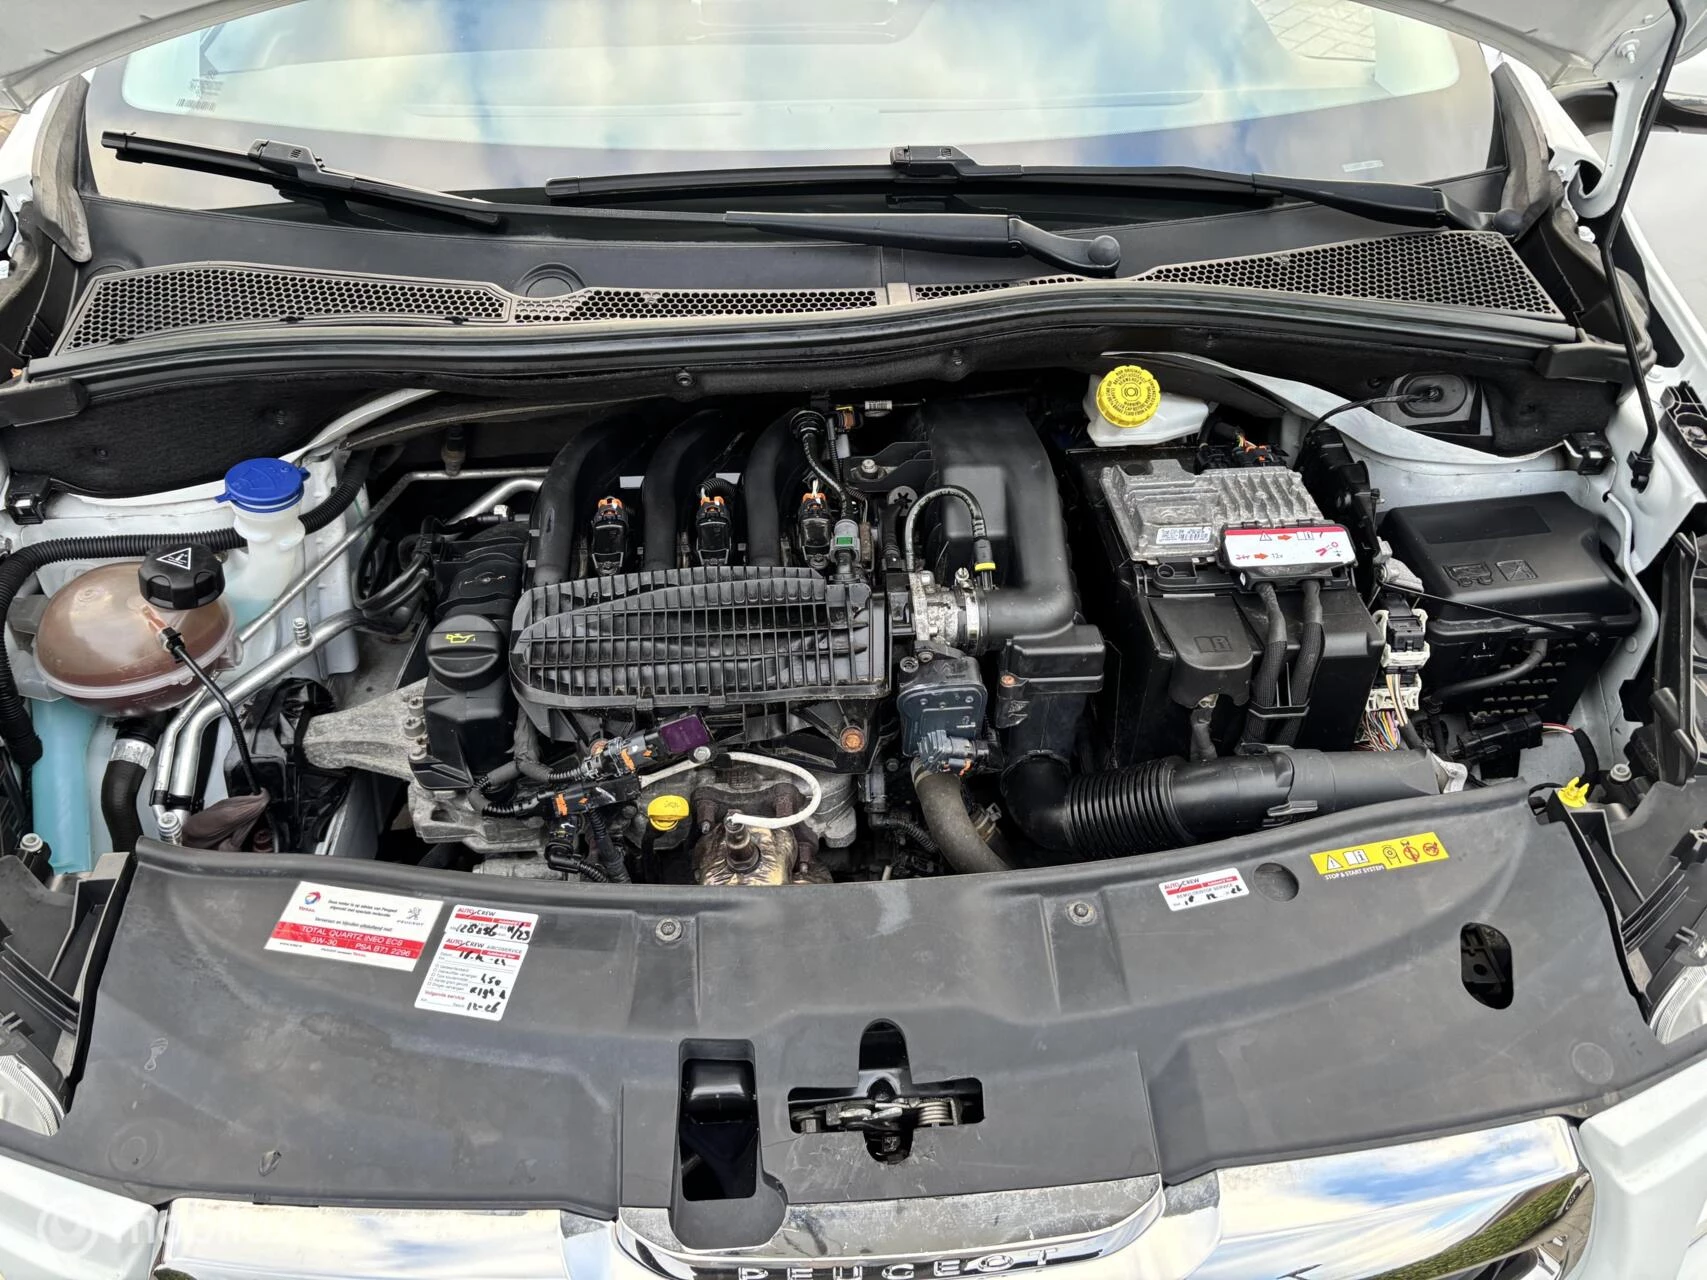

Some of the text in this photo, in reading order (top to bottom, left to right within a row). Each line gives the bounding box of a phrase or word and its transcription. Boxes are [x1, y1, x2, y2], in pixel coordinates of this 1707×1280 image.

[1325, 872, 1340, 880] STOP
[1345, 868, 1362, 877] START
[1363, 865, 1385, 874] SYSTEM
[476, 909, 496, 917] CREW
[302, 926, 328, 936] TOTAL
[329, 929, 363, 941] QUARTZ
[310, 936, 338, 946] 5W-30
[354, 942, 372, 951] PSA
[373, 945, 389, 954] B71
[391, 948, 411, 957] 2296
[465, 940, 485, 949] CREW
